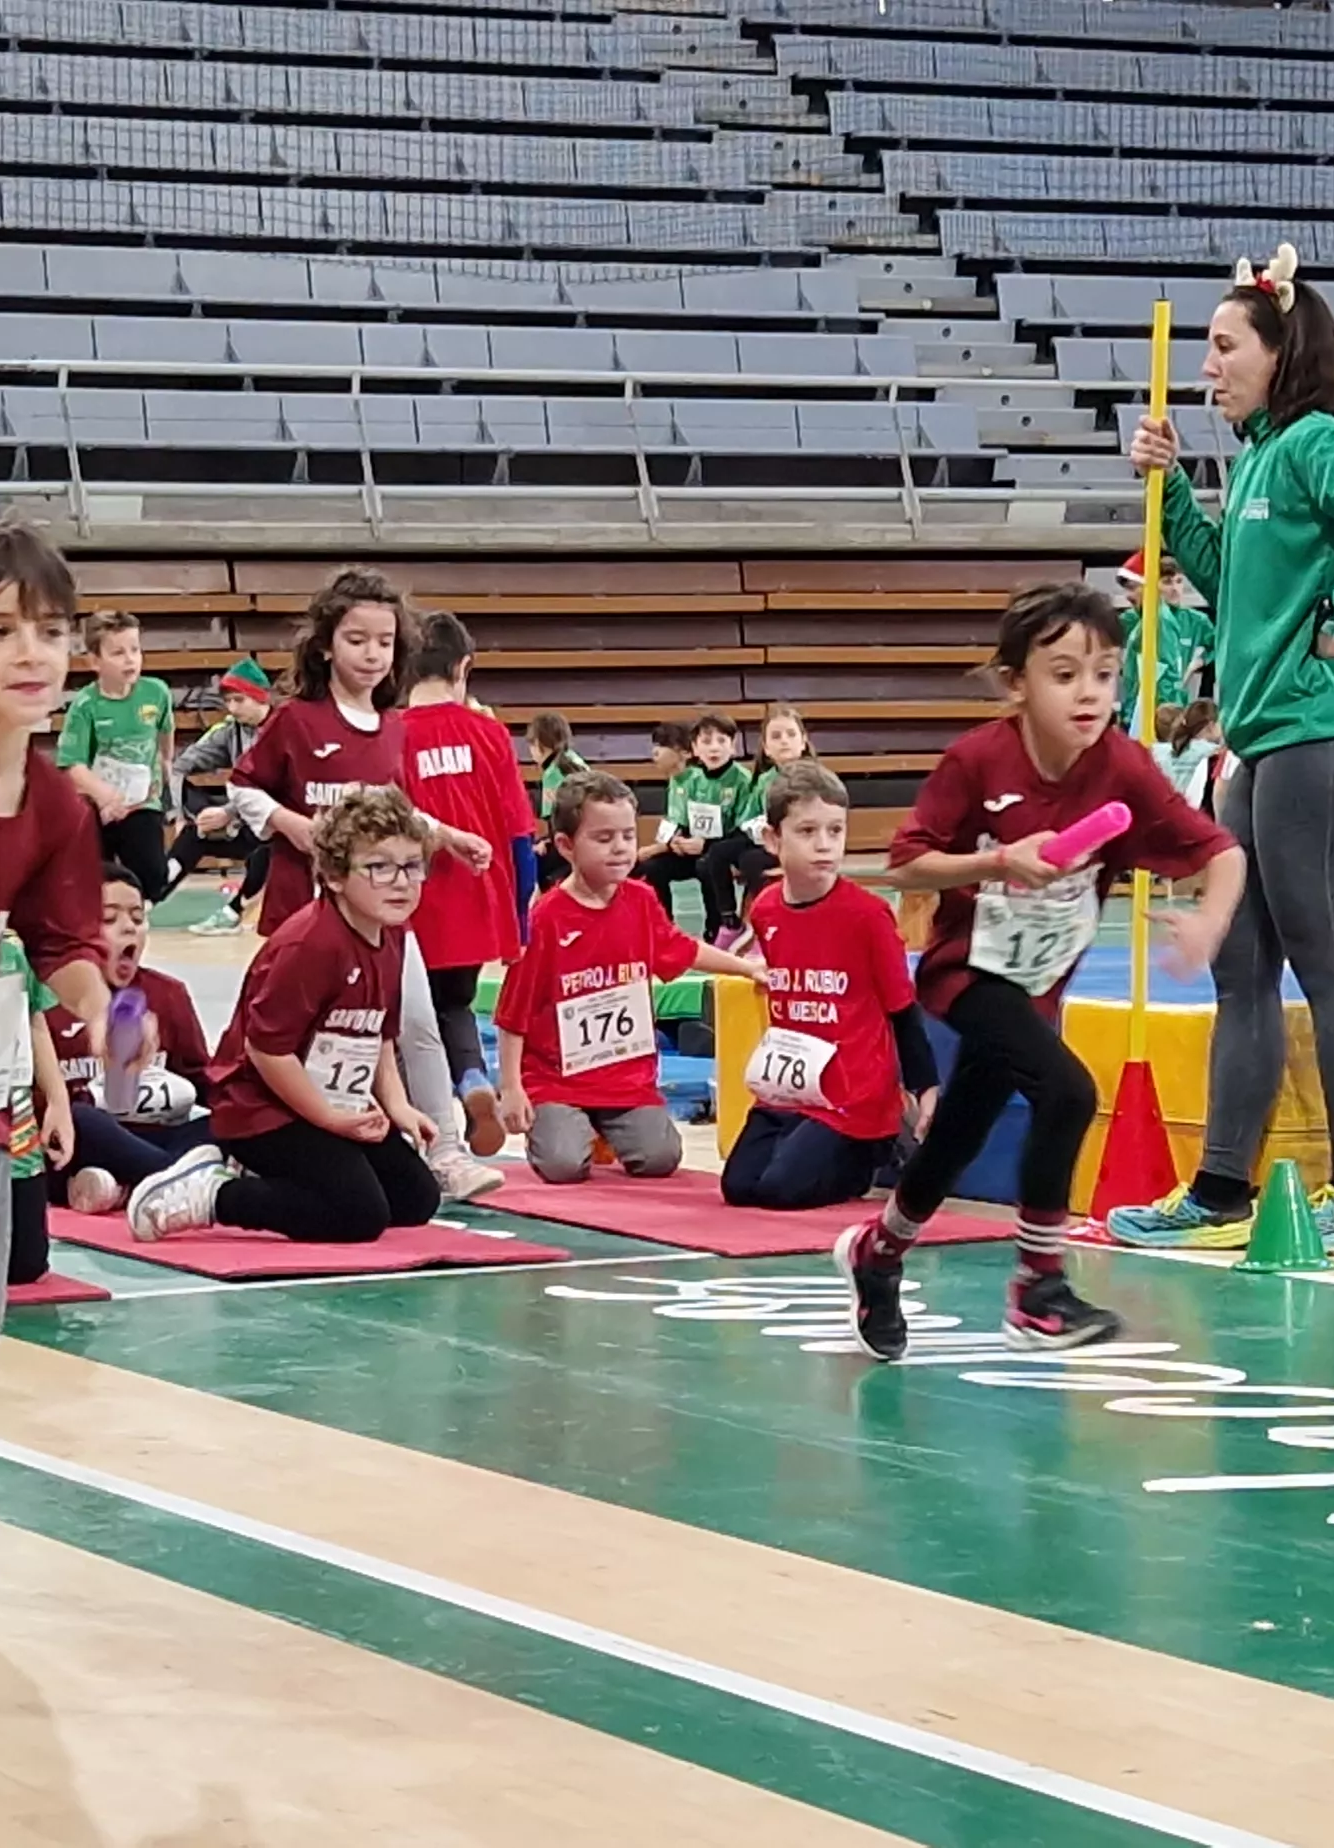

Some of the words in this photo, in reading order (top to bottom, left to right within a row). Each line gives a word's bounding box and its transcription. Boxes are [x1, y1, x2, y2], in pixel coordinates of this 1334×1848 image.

[417, 744, 473, 780] ALAN
[578, 1005, 635, 1047] 176
[762, 1050, 806, 1091] 178
